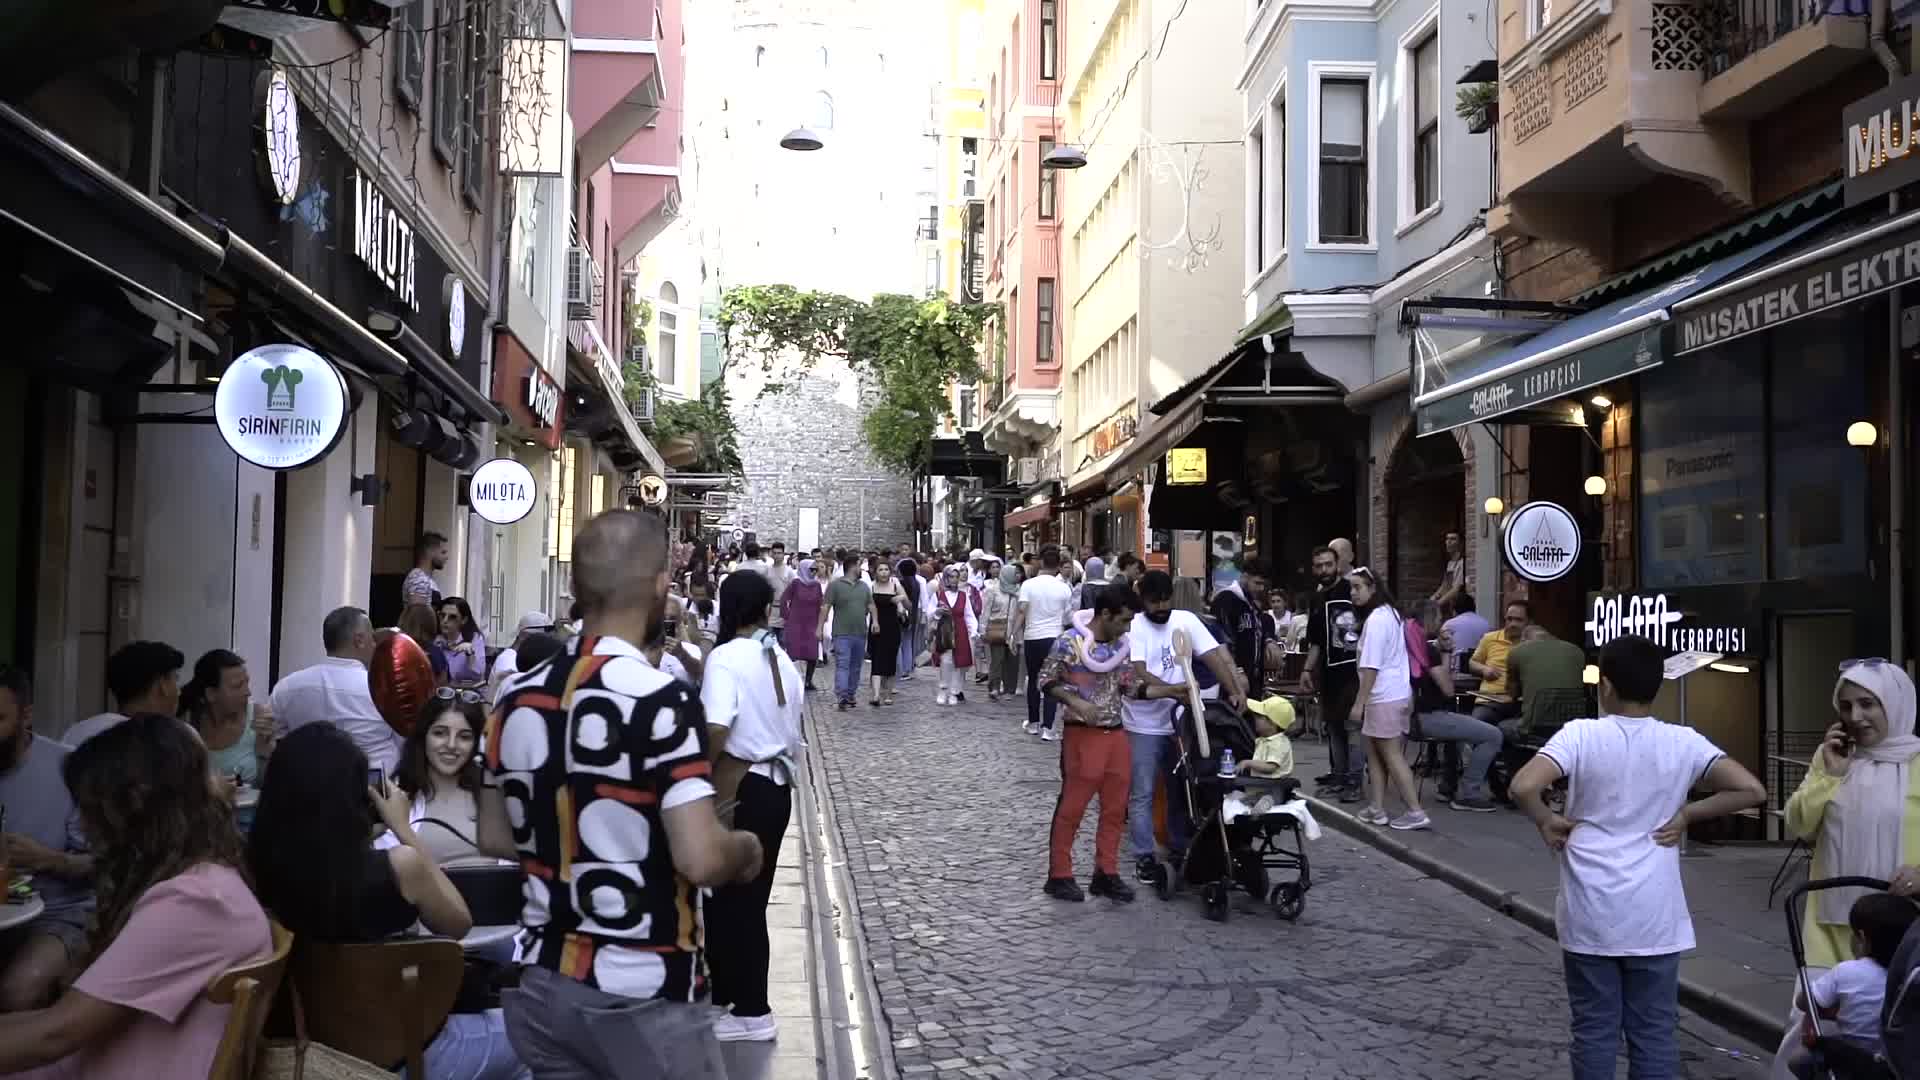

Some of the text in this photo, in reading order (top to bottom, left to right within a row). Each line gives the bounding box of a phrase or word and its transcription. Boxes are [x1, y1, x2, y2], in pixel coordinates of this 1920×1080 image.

[1849, 98, 1920, 178] MU
[1684, 284, 1800, 350] MUSATEK
[1469, 359, 1581, 416] GALATA KEBAPÇISI
[1665, 448, 1735, 478] Panasonic
[1518, 545, 1570, 562] GALATA
[1585, 593, 1683, 647] GALATA
